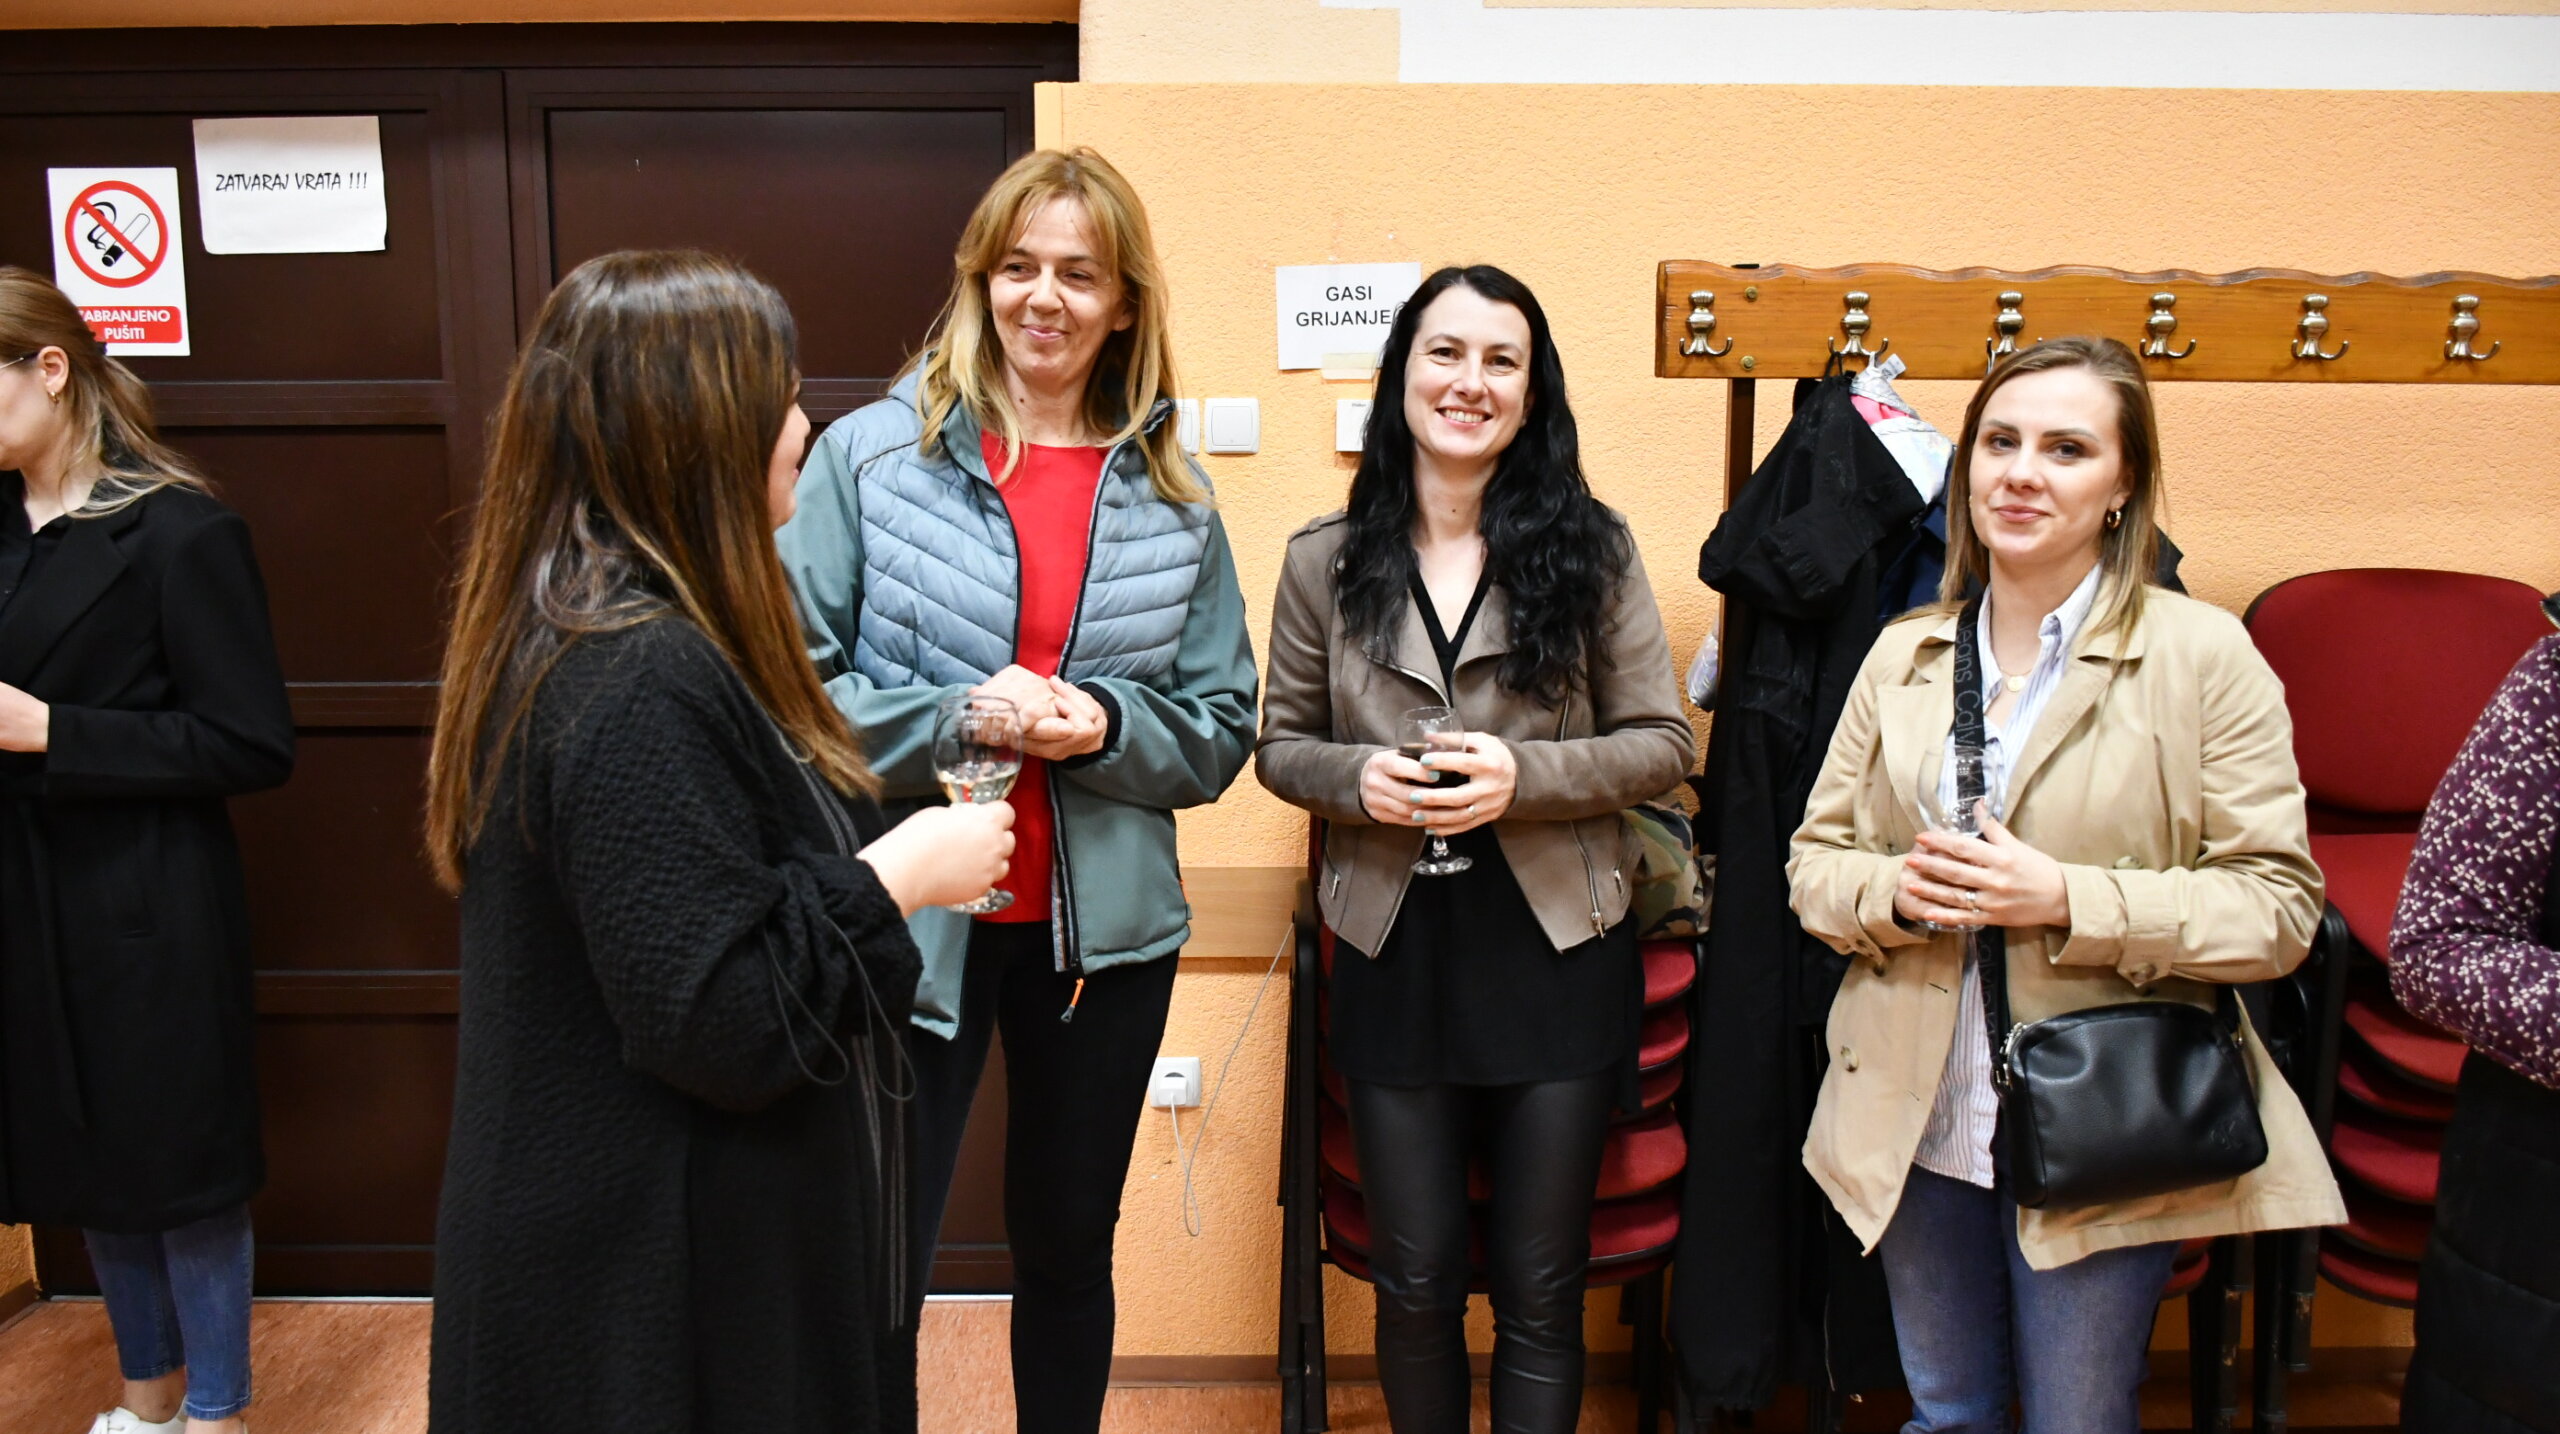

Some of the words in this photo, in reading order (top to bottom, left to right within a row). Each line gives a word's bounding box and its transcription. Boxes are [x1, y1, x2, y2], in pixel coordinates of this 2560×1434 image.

[215, 173, 289, 192] ZATVARAJ
[295, 172, 341, 190] VRATA
[349, 171, 367, 189] !!!
[1325, 285, 1372, 301] GASI
[1296, 309, 1392, 327] GRIJANJE
[104, 324, 145, 340] PUŠITI
[1954, 621, 1977, 683] Jeans
